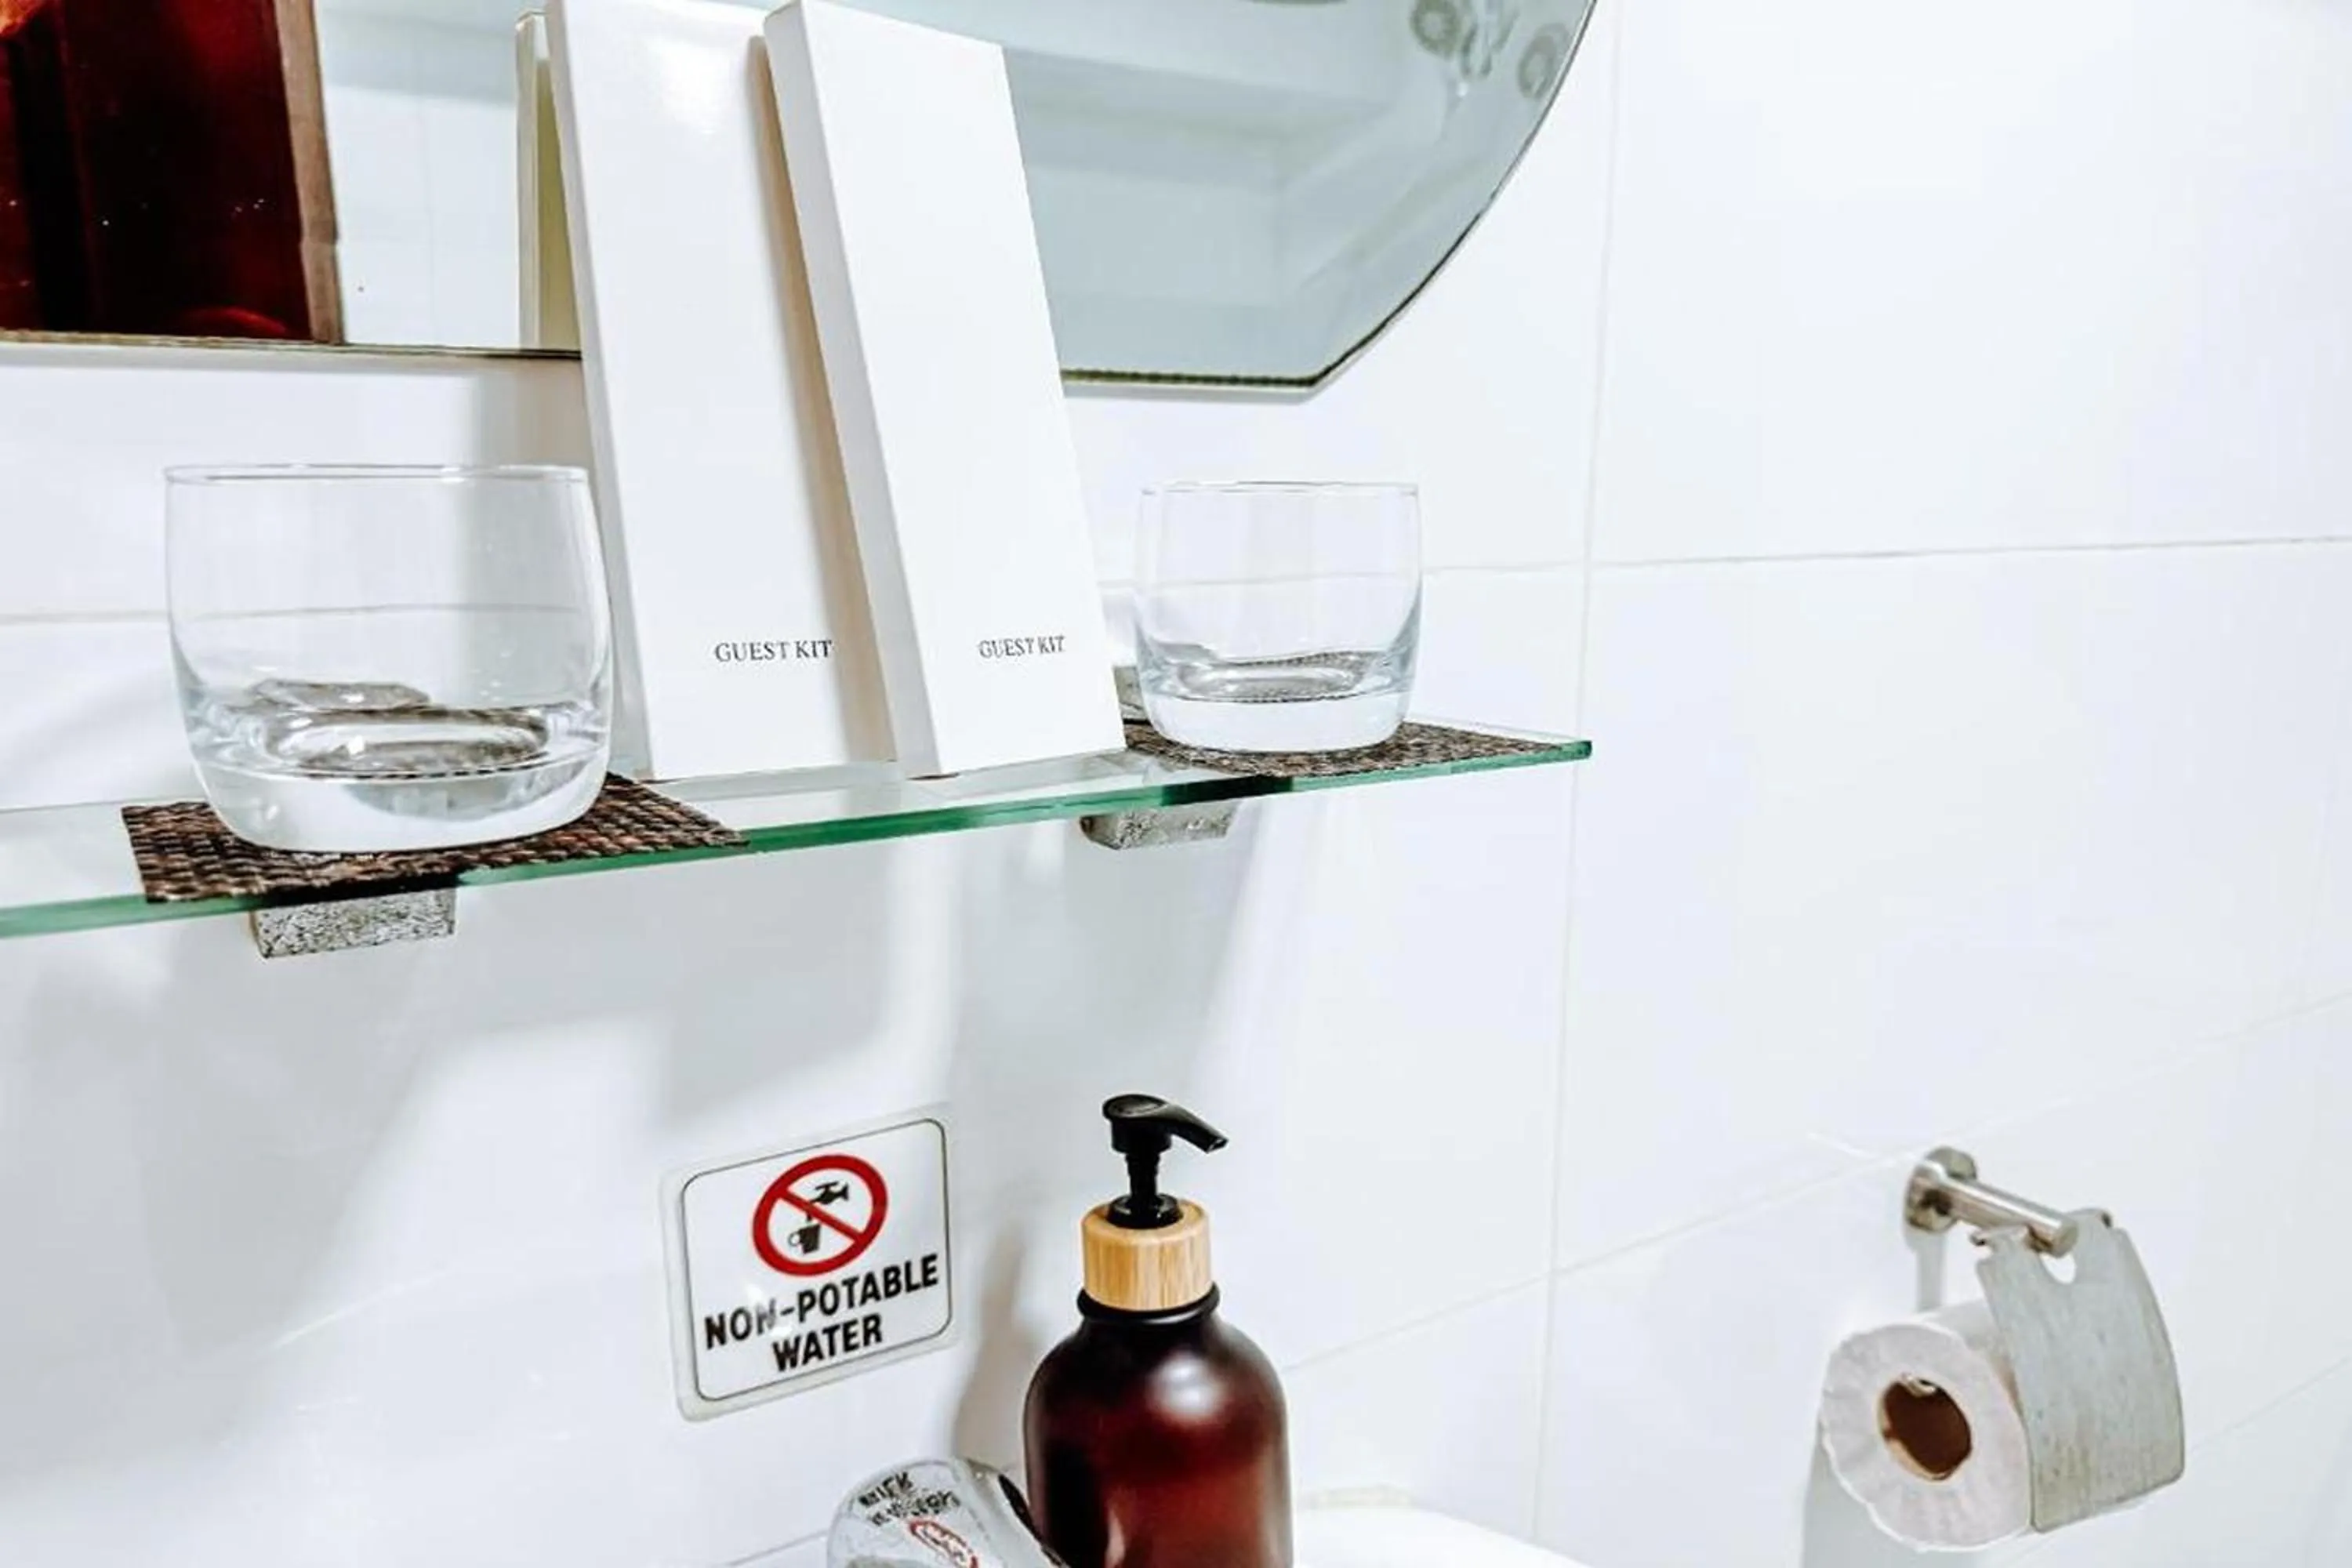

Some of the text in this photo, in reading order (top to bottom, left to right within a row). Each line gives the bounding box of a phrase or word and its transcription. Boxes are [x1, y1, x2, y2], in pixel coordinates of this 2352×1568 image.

[714, 639, 833, 662] GUEST KIT
[977, 634, 1065, 659] GUEST KIT
[704, 1253, 938, 1350] NON-POTABLE
[771, 1312, 884, 1372] WATER
